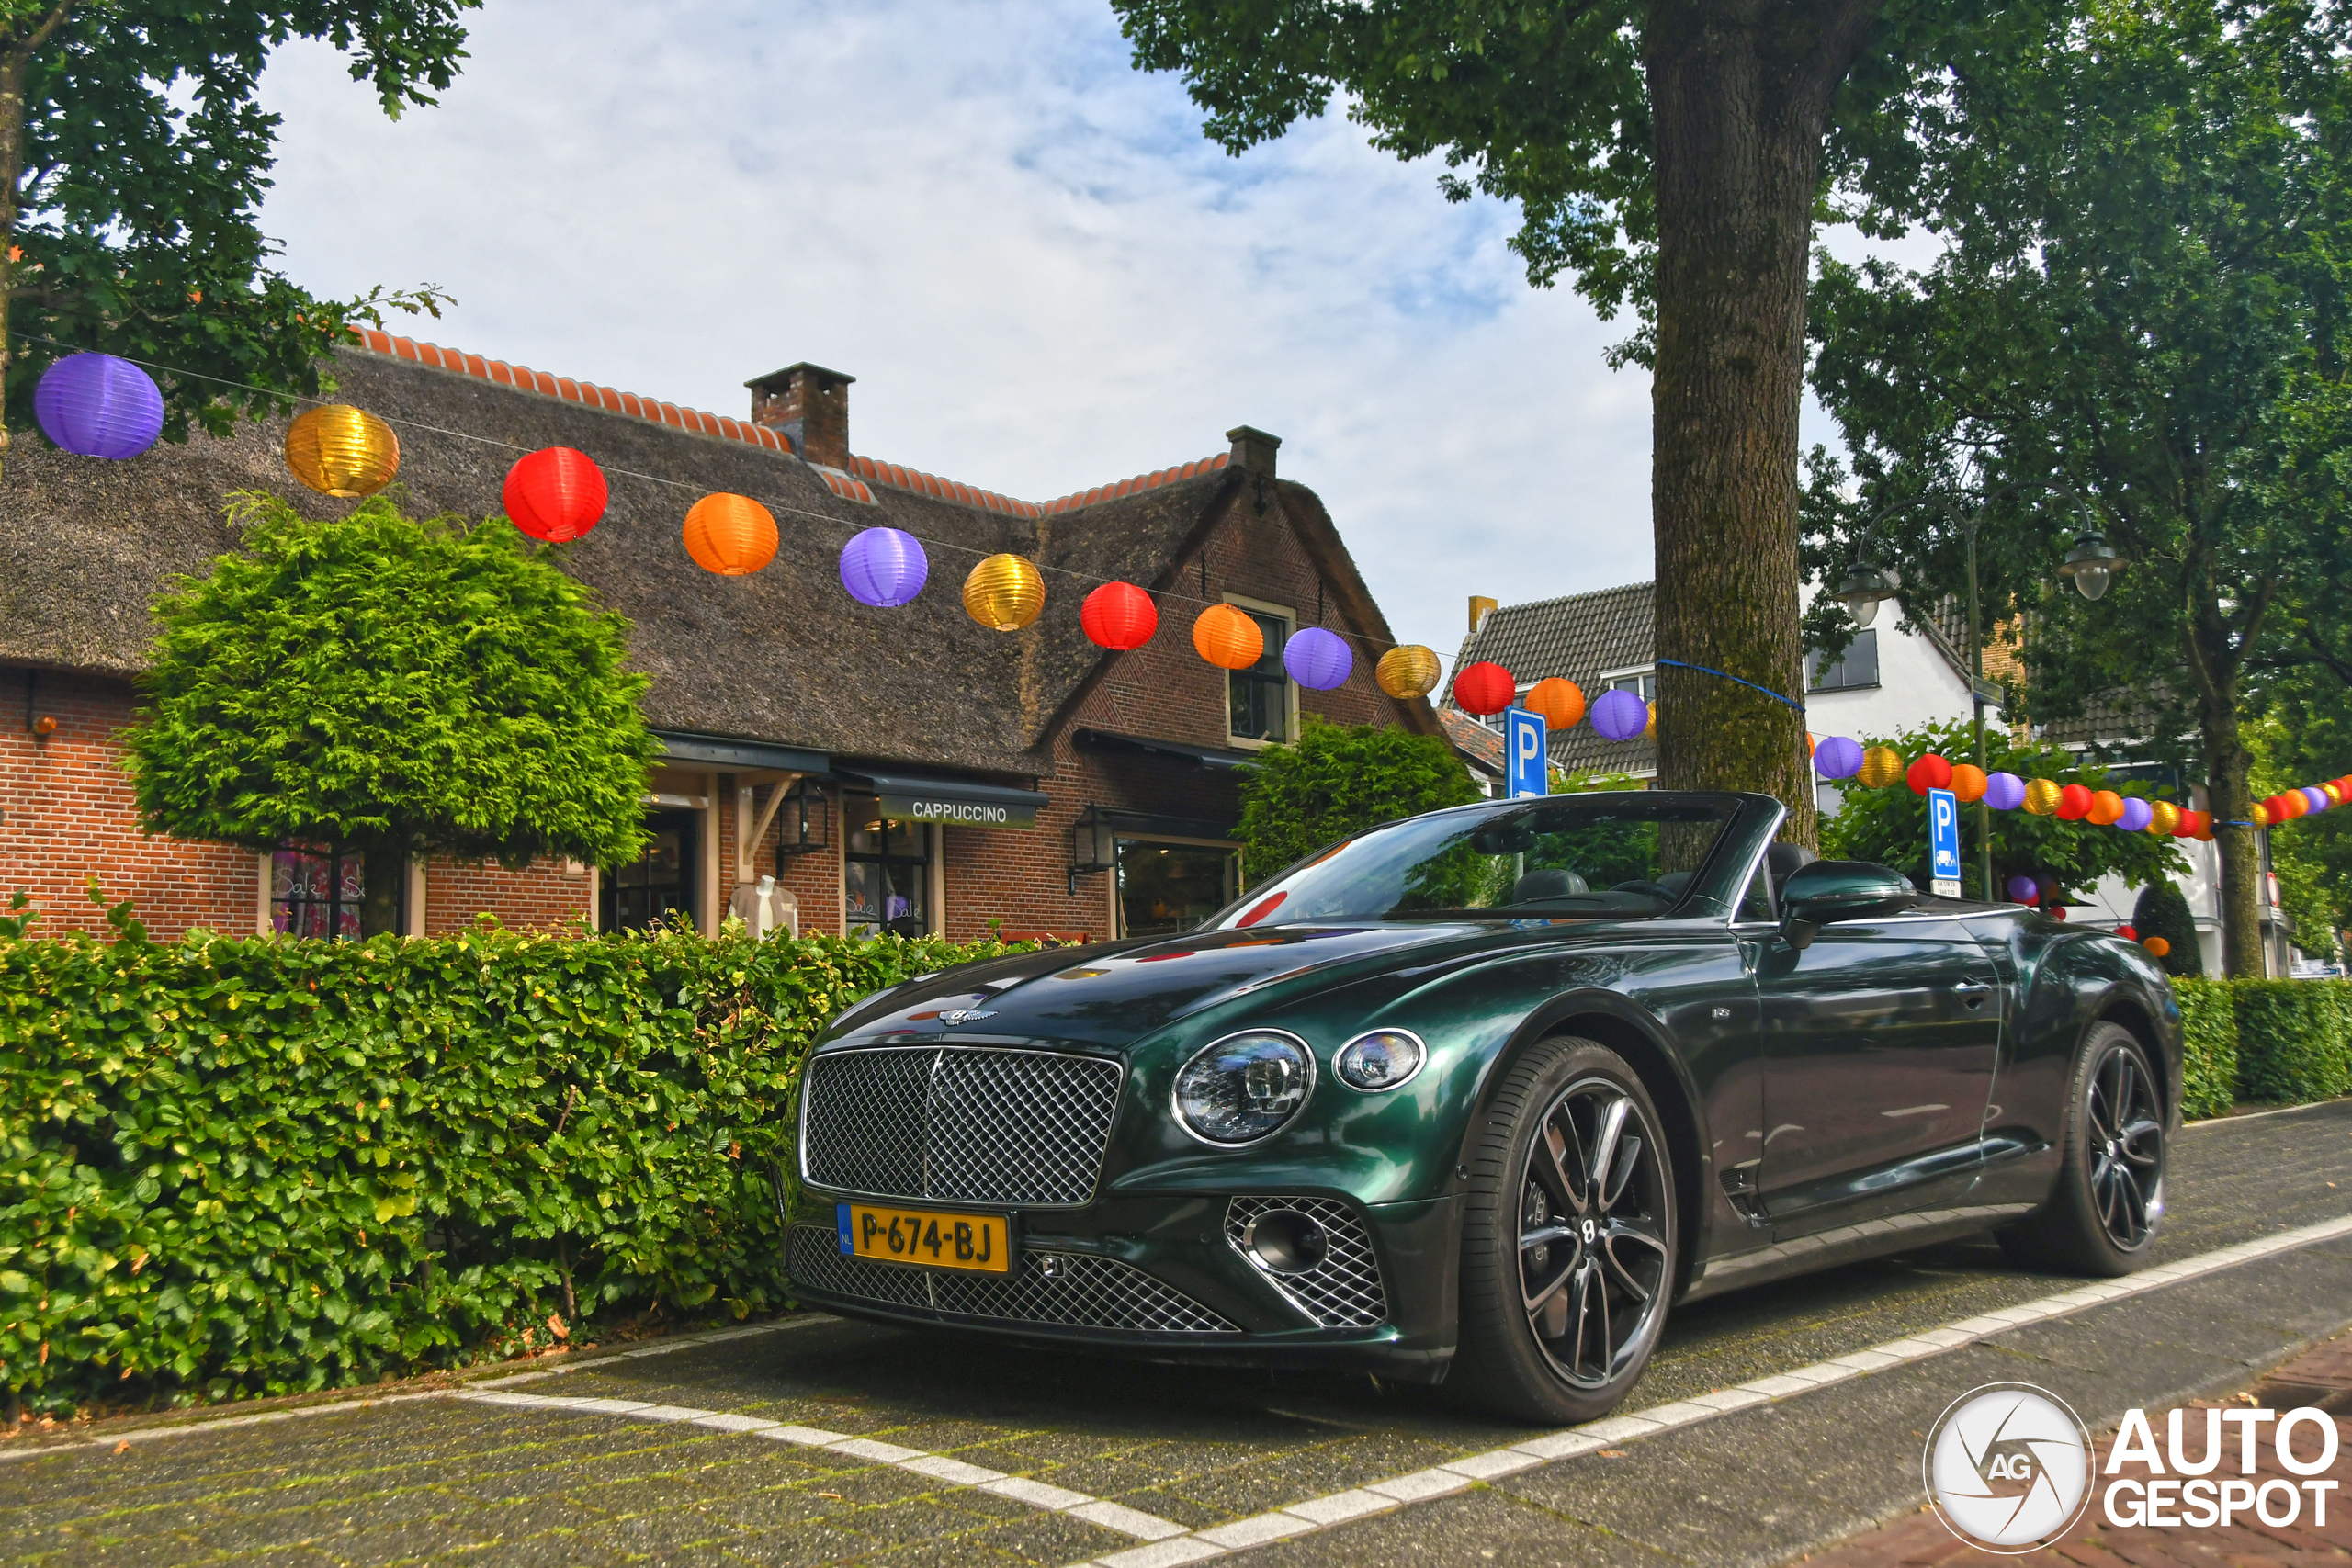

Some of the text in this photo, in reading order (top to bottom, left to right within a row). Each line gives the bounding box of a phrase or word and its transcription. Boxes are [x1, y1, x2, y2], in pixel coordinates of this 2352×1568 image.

[1518, 722, 1539, 780] P
[912, 801, 1007, 823] CAPPUCCINO
[1936, 798, 1951, 842] P
[275, 867, 322, 895] Sale
[845, 893, 922, 919] Sale Sale
[841, 1234, 852, 1245] NL
[861, 1213, 991, 1262] P-674-BJ
